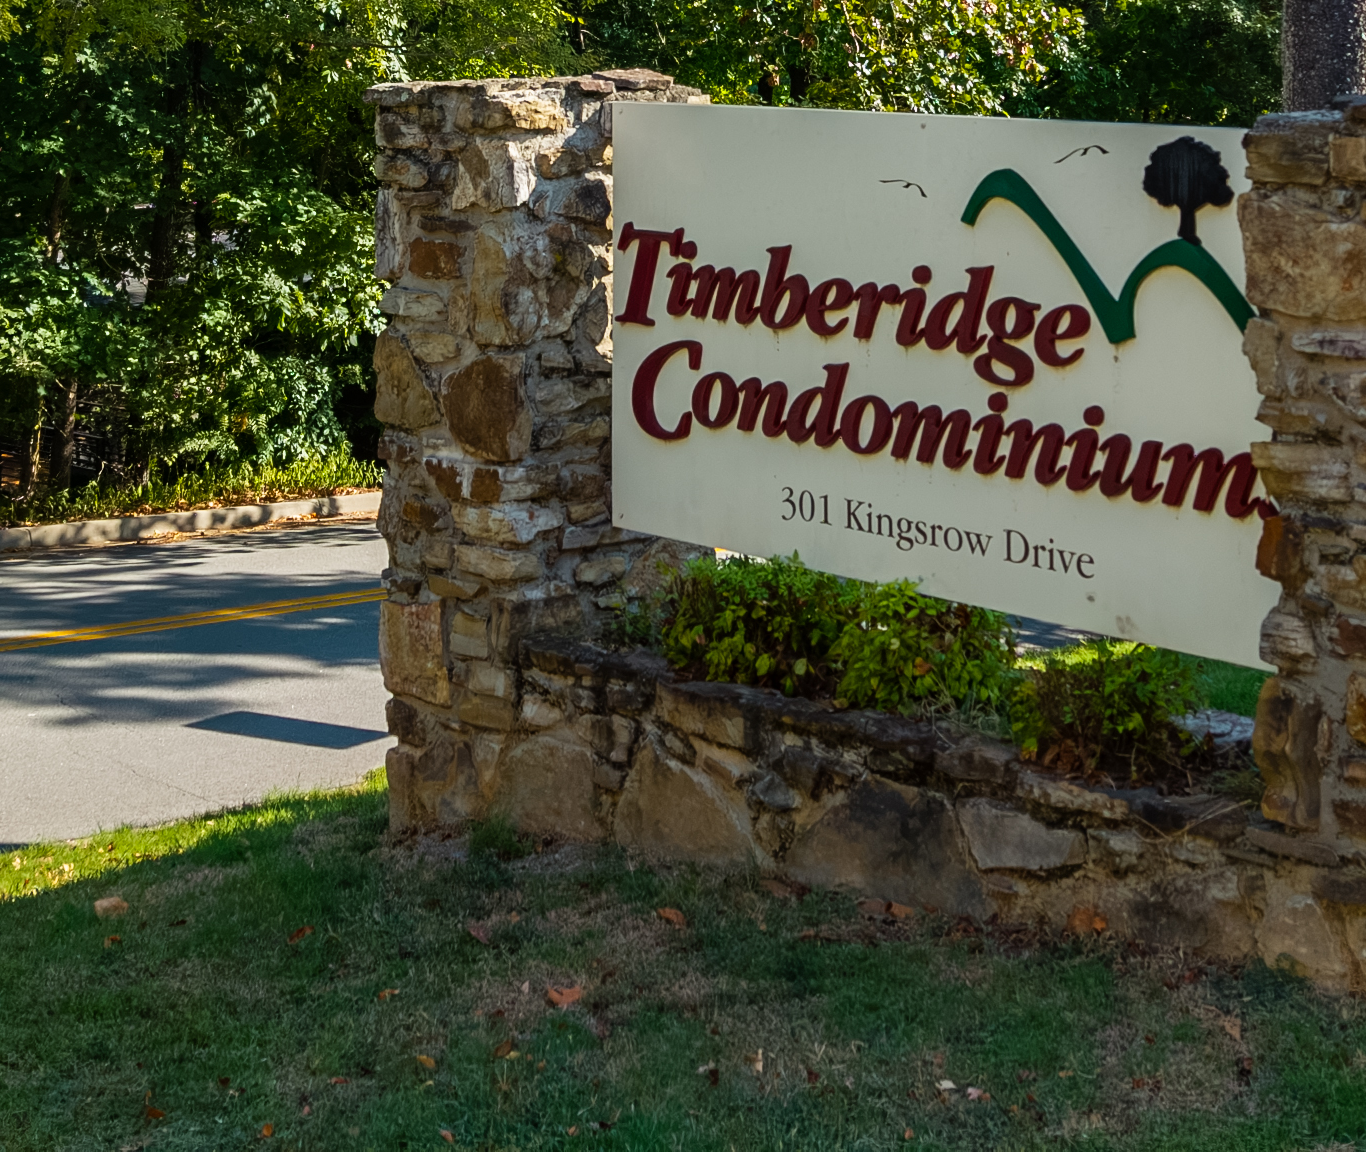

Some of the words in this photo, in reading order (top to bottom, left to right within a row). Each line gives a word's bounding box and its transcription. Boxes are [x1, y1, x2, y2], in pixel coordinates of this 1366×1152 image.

[615, 221, 1092, 387] Timberidge
[631, 339, 1280, 520] Condominium
[781, 486, 833, 526] 301
[843, 497, 994, 557] Kingsrow
[1002, 528, 1095, 579] Drive
